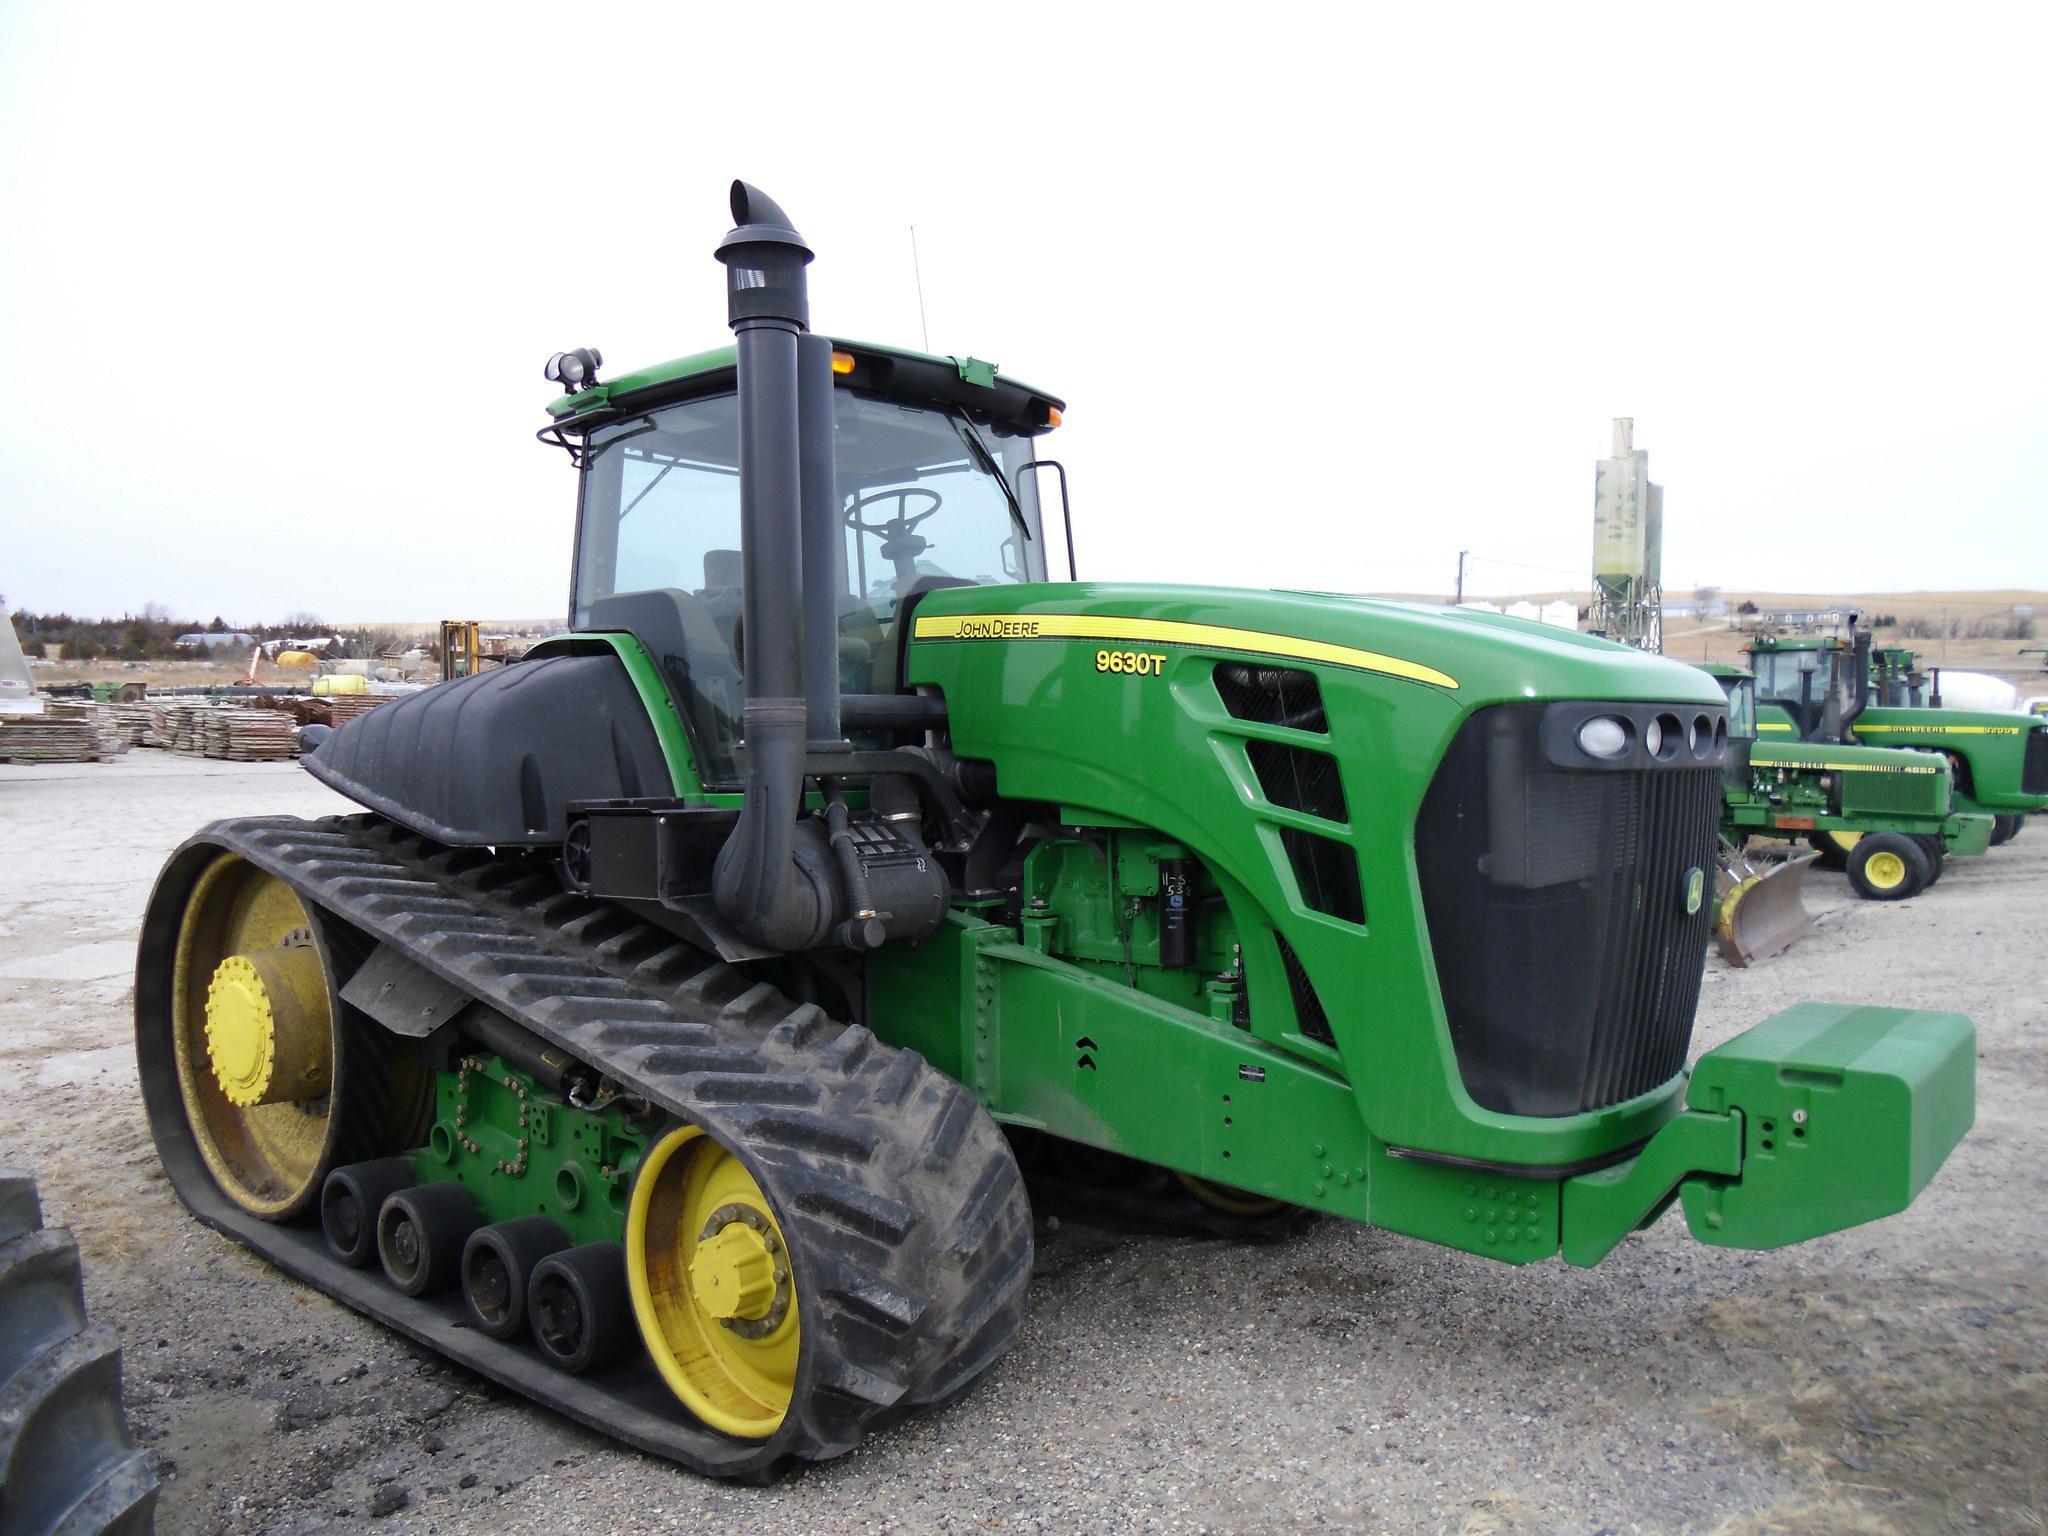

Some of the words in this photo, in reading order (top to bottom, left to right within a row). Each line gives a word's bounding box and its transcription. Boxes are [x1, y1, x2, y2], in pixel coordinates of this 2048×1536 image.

[956, 620, 991, 636] JOHN
[992, 619, 1040, 636] DEERE
[1095, 649, 1167, 677] 9630T
